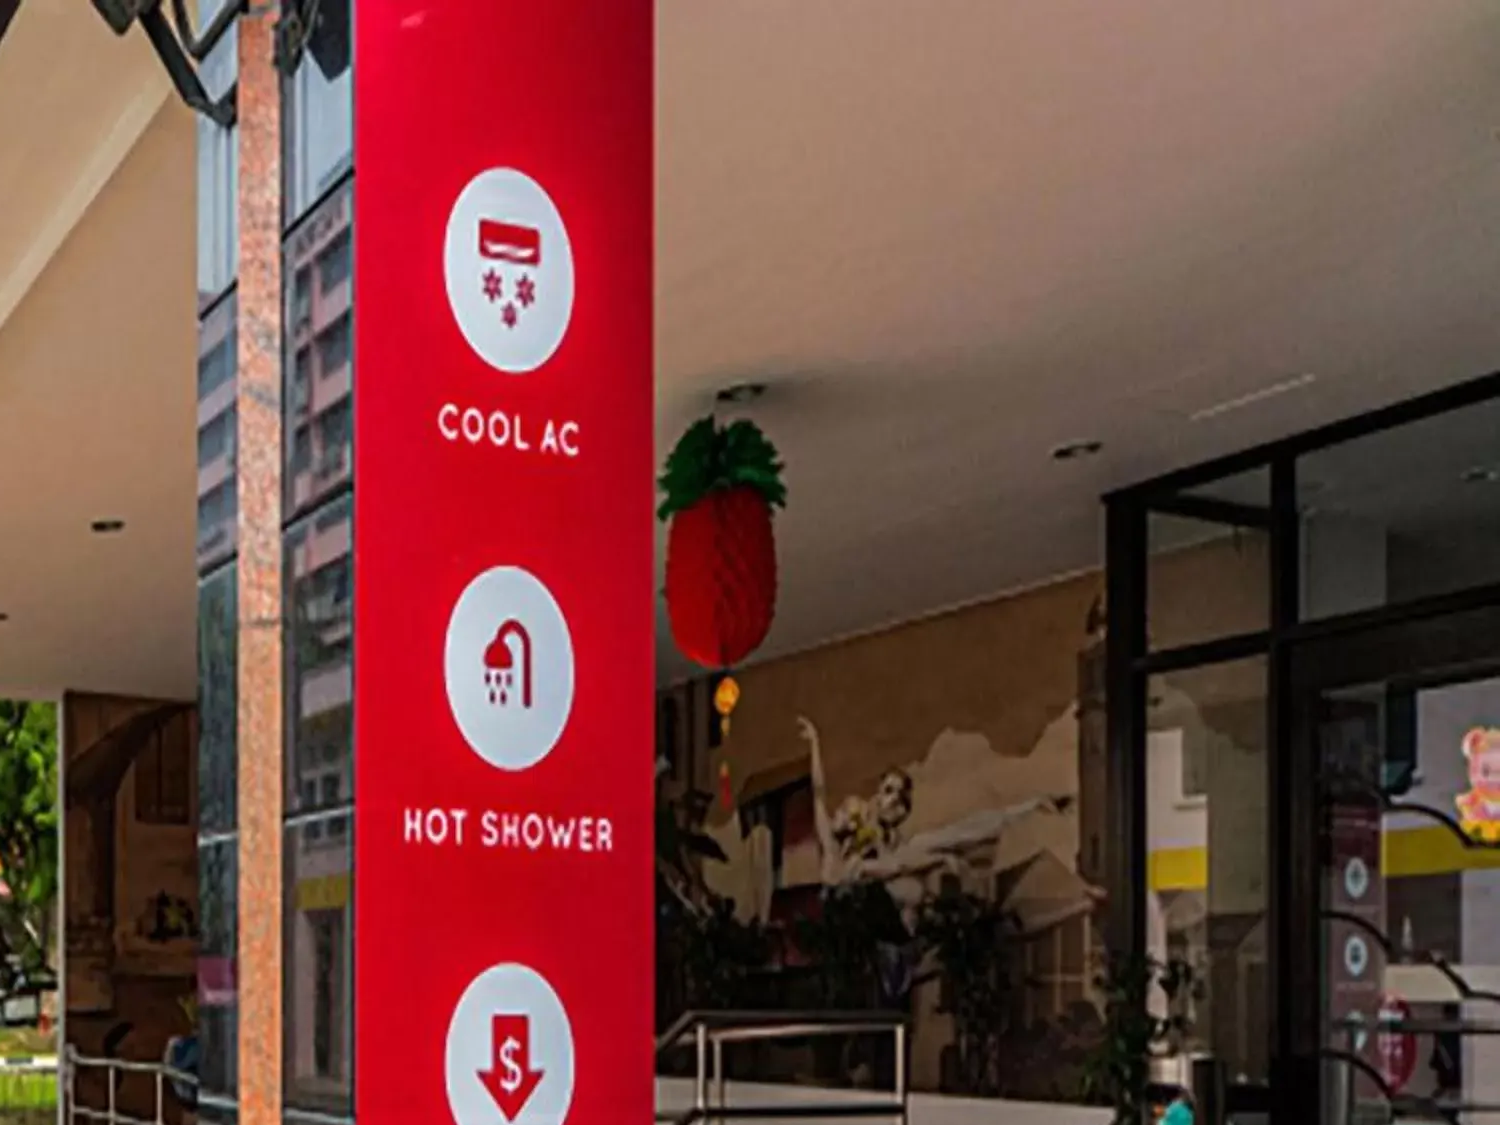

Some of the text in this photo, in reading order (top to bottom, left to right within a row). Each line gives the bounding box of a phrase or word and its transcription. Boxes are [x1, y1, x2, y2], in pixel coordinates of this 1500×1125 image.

[437, 403, 580, 457] COOL AC
[404, 807, 613, 852] HOT SHOWER
[499, 1036, 523, 1093] $
